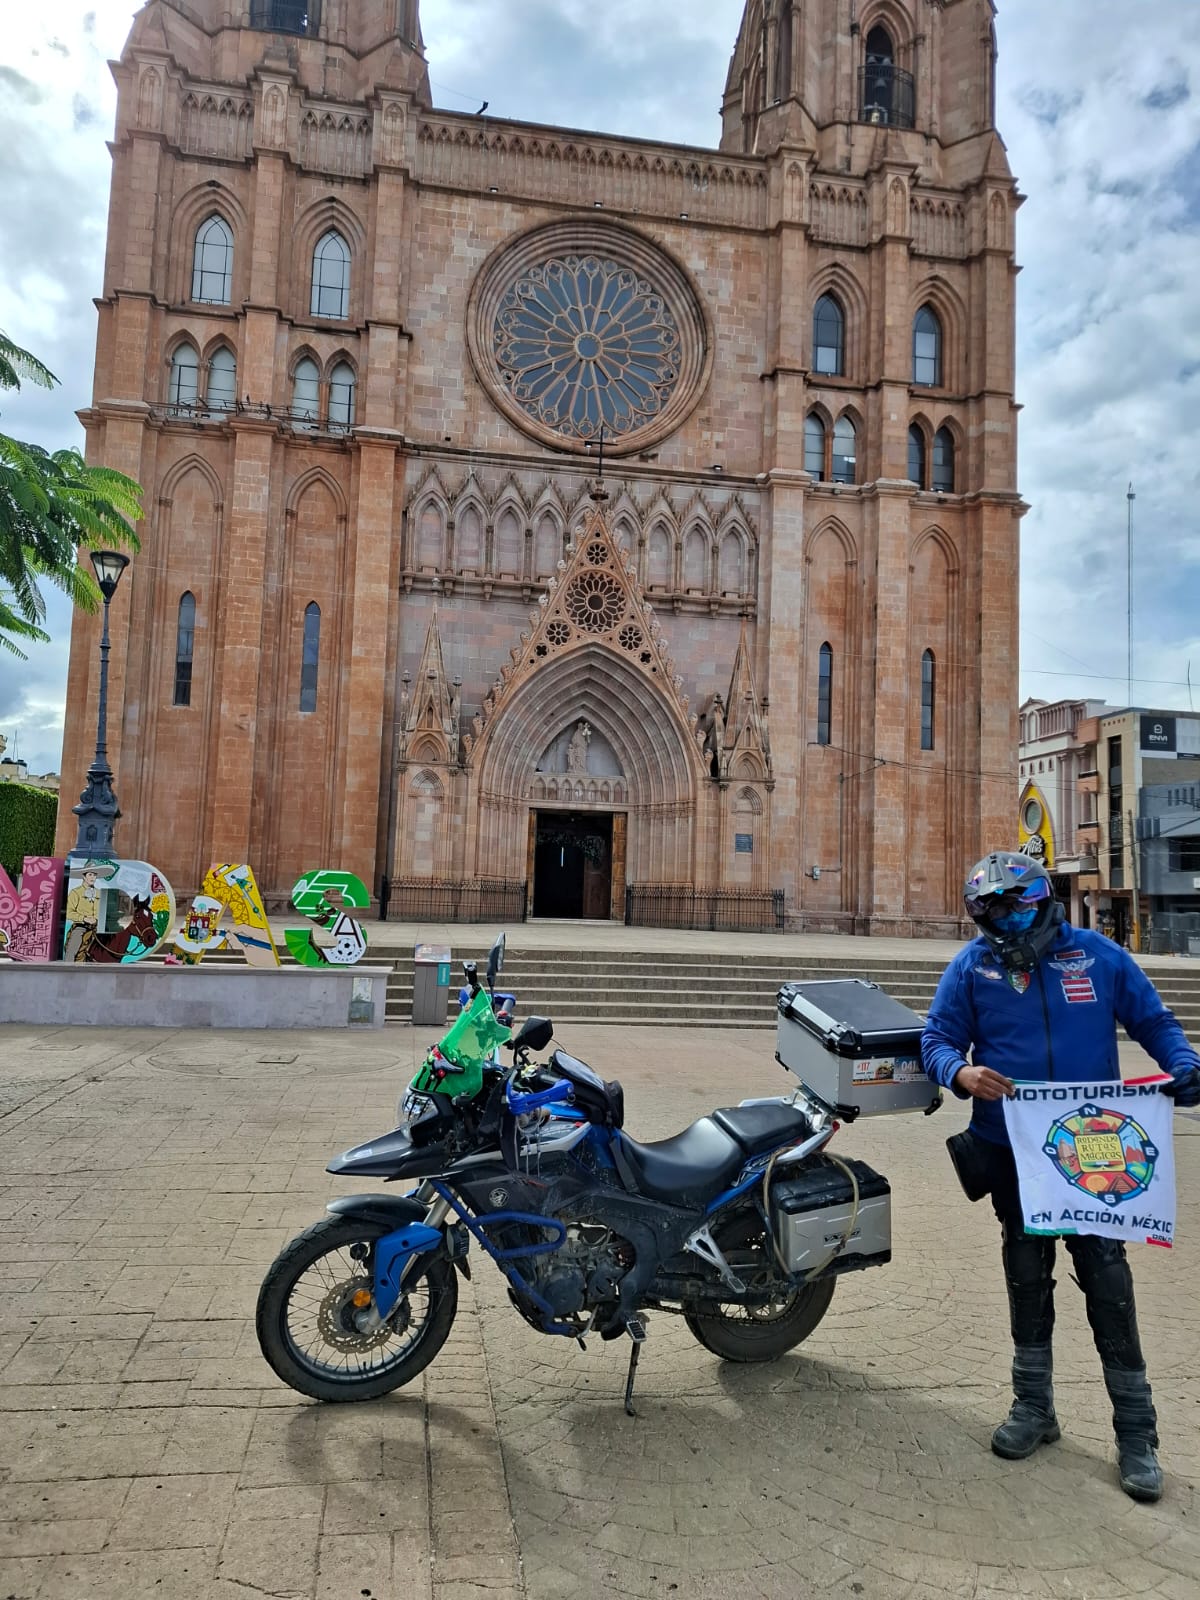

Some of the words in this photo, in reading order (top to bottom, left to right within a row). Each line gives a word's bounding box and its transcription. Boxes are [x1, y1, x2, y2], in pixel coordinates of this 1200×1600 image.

[1006, 1084, 1160, 1102] MOTOTURISM
[1031, 1211, 1052, 1224] EN
[1060, 1208, 1125, 1226] ACCIÓN
